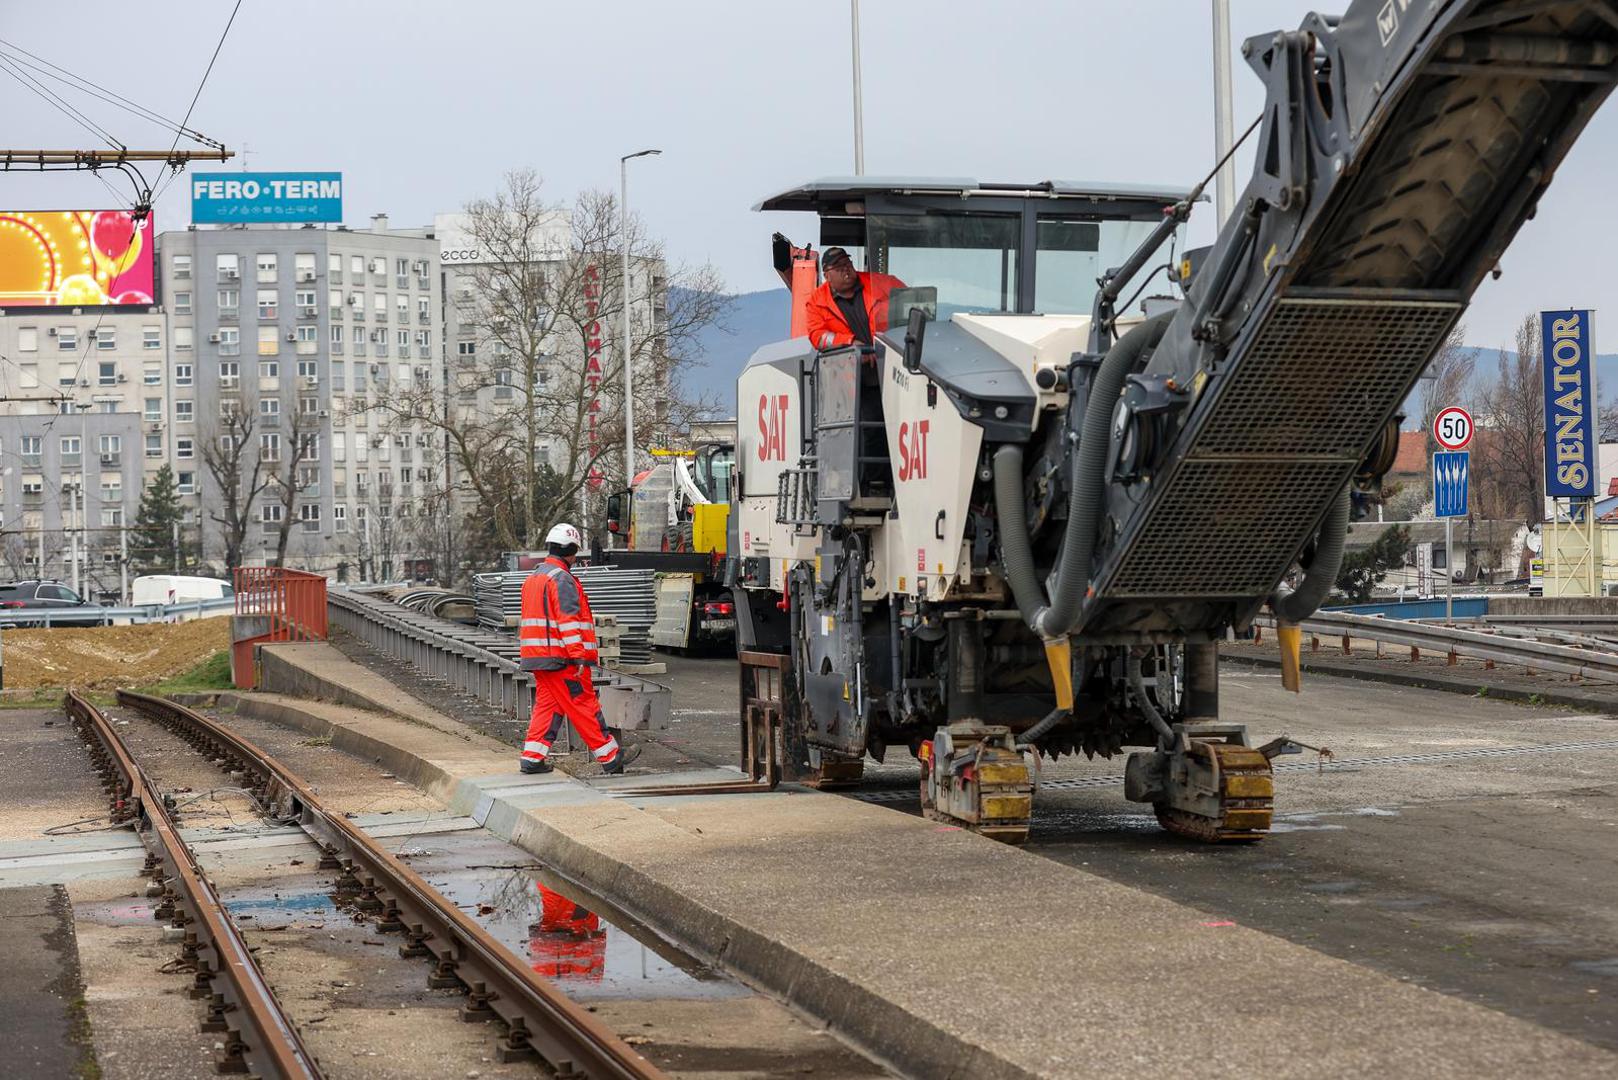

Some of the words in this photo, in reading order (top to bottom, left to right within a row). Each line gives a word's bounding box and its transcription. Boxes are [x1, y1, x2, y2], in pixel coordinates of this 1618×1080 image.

[441, 249, 480, 261] ecco
[758, 394, 789, 462] SAT
[1443, 417, 1466, 440] 50
[1552, 313, 1590, 490] SENATOR
[898, 420, 930, 482] SAT
